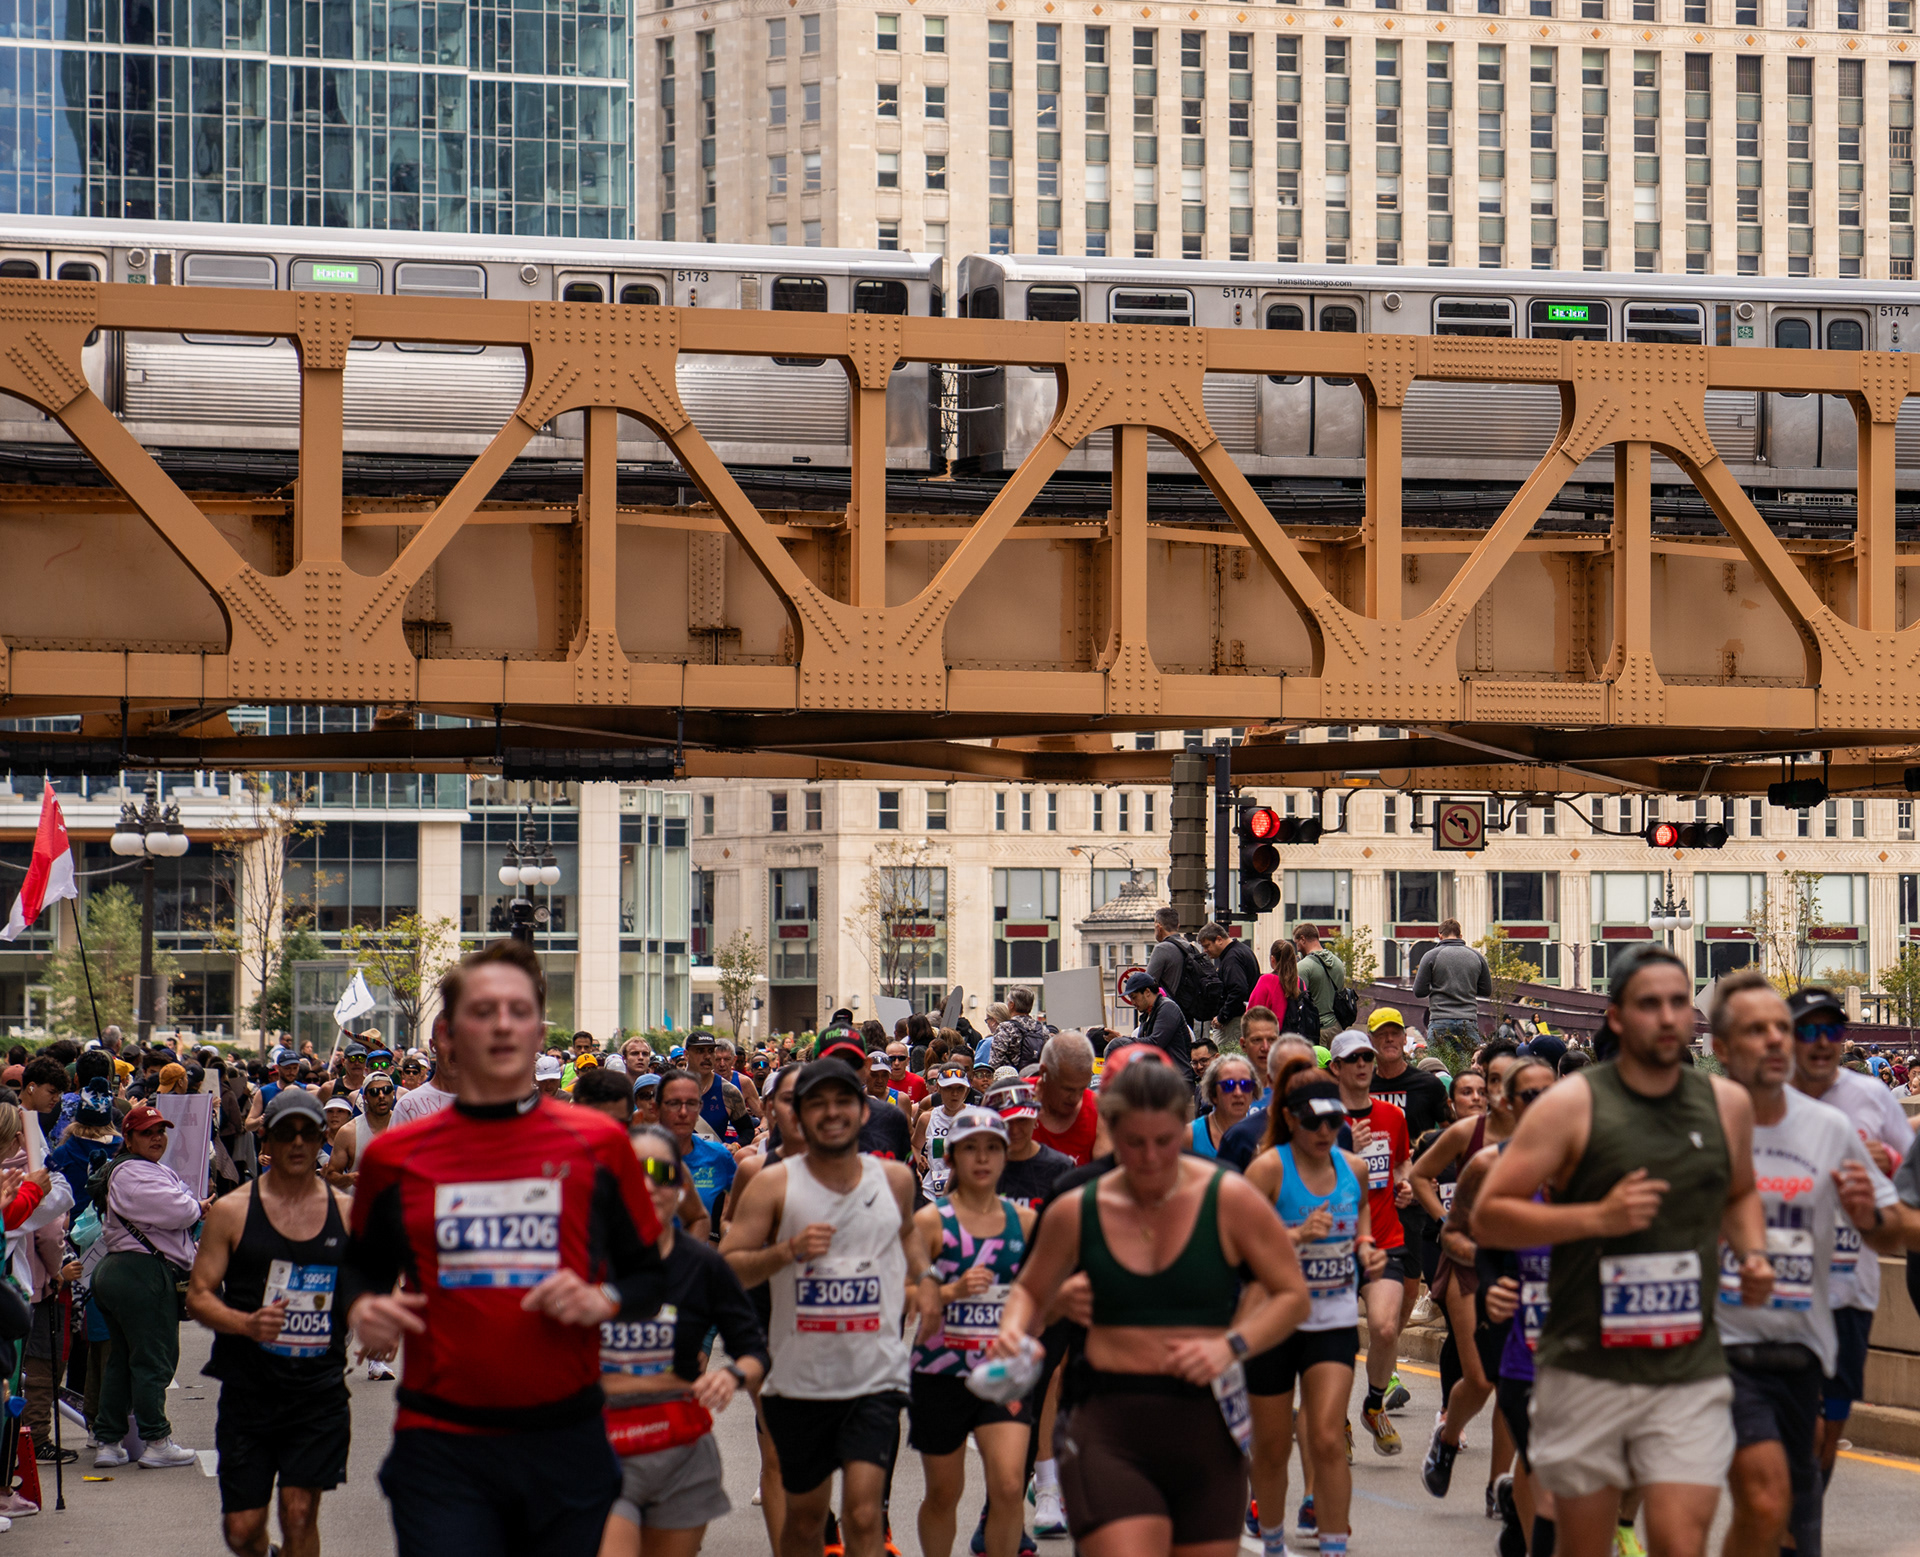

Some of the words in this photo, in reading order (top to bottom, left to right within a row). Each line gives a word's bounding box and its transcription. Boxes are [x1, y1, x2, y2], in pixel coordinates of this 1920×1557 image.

[677, 271, 709, 282] 5173
[1277, 278, 1352, 287] transitchicago.com
[1222, 287, 1253, 298] 5174
[1880, 306, 1909, 316] 5174
[1366, 1156, 1389, 1171] 0997
[1755, 1171, 1814, 1202] cago
[436, 1218, 459, 1250] G
[464, 1215, 559, 1249] 41206
[798, 1281, 811, 1302] F
[815, 1279, 879, 1304] 30679
[1603, 1287, 1620, 1313] F
[1625, 1281, 1700, 1312] 28273
[280, 1312, 331, 1333] 50054
[947, 1305, 960, 1323] H
[963, 1304, 1005, 1325] 2630
